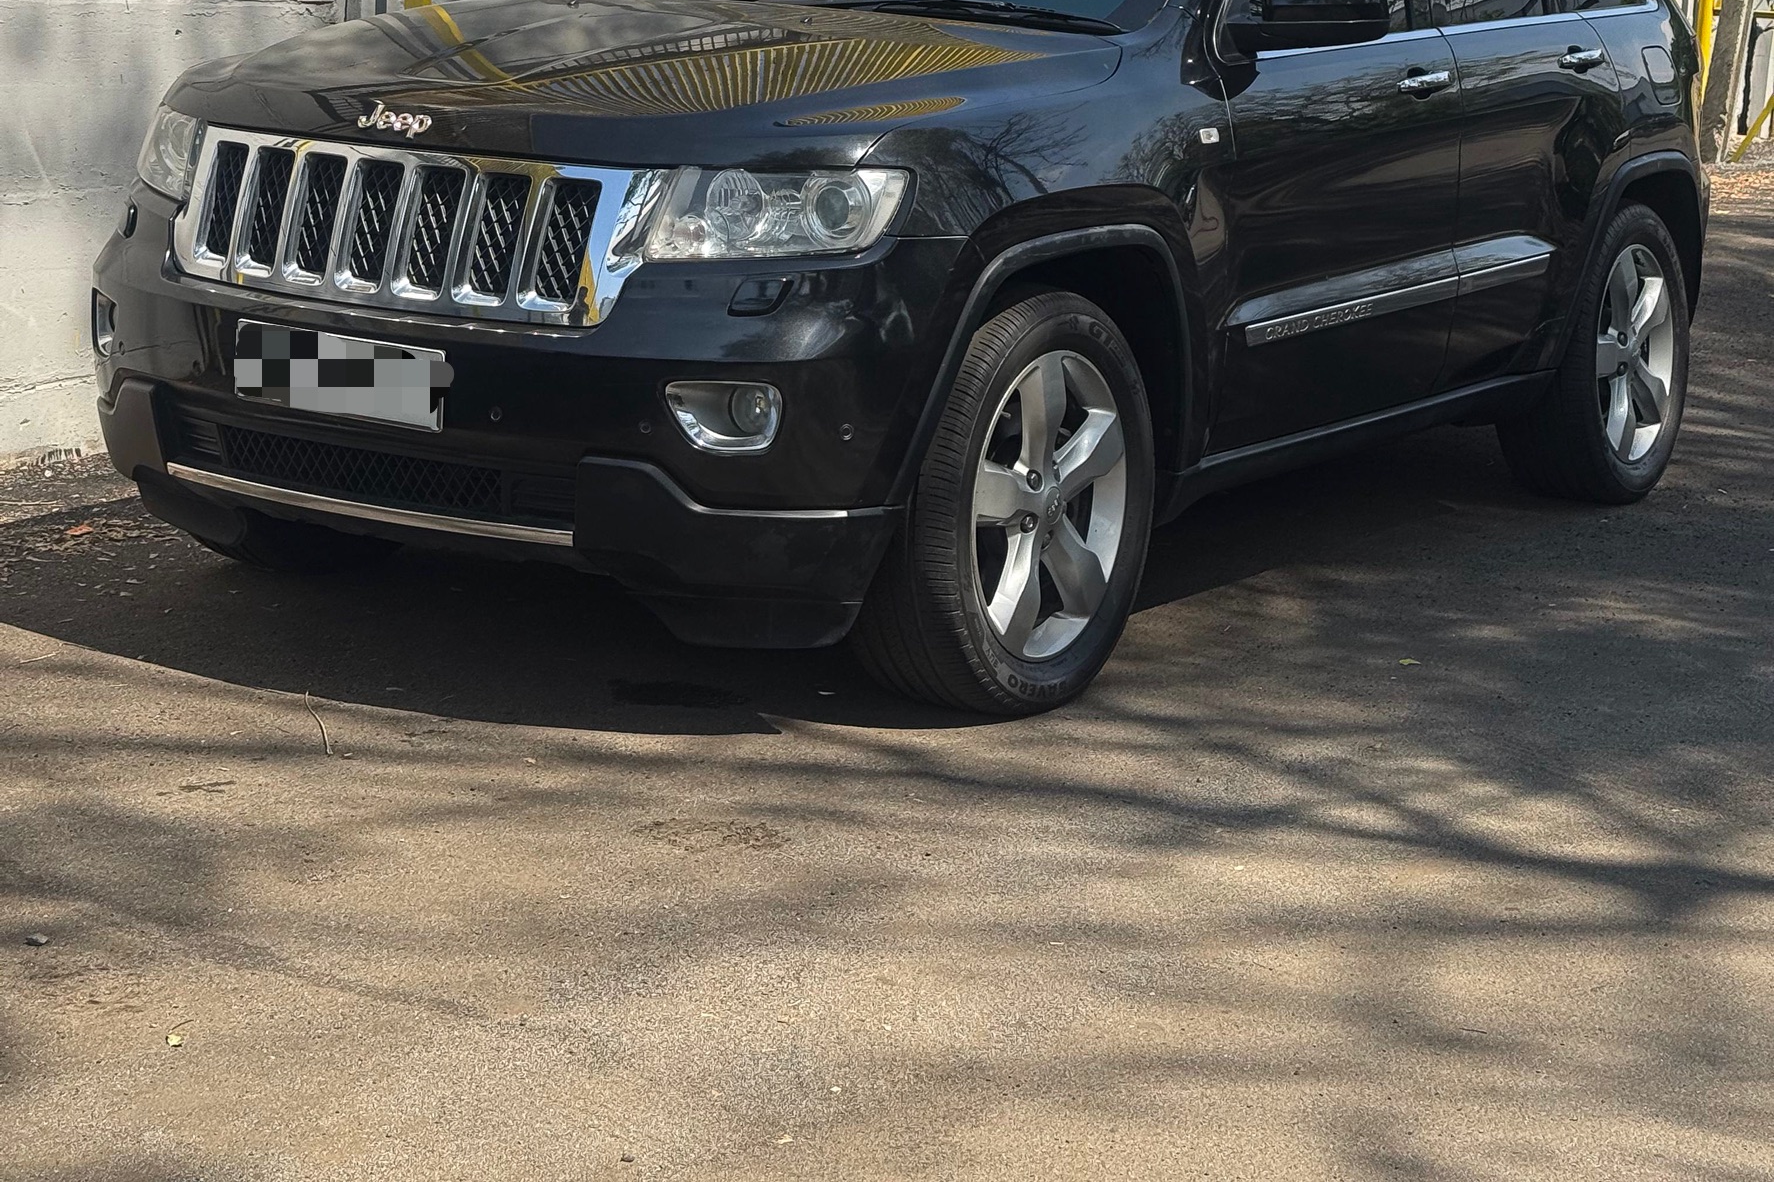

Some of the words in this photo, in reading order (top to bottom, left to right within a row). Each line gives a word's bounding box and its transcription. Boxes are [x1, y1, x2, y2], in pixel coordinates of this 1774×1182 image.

[357, 99, 432, 138] Jeep
[1265, 319, 1310, 340] GRAND
[1313, 303, 1373, 329] CHEROKEE
